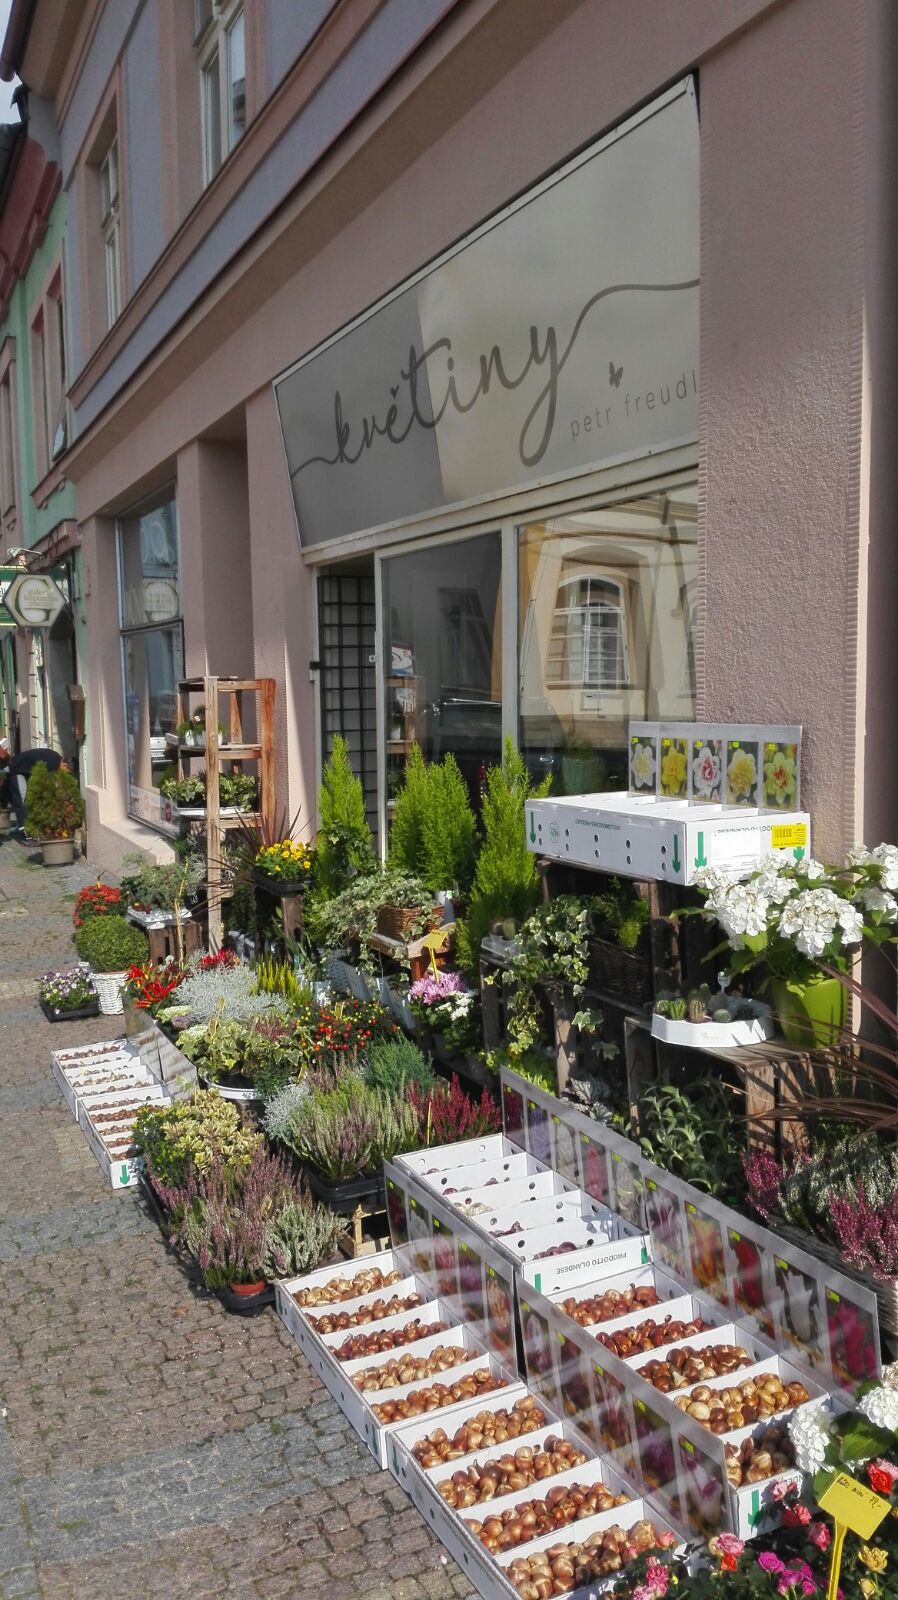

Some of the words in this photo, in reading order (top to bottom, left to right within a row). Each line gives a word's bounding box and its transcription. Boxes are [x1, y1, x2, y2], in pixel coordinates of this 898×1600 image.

[312, 302, 602, 467] květiny
[571, 408, 611, 441] petr
[556, 1259, 590, 1275] OLANDESE
[592, 1252, 626, 1265] PRODOTTO
